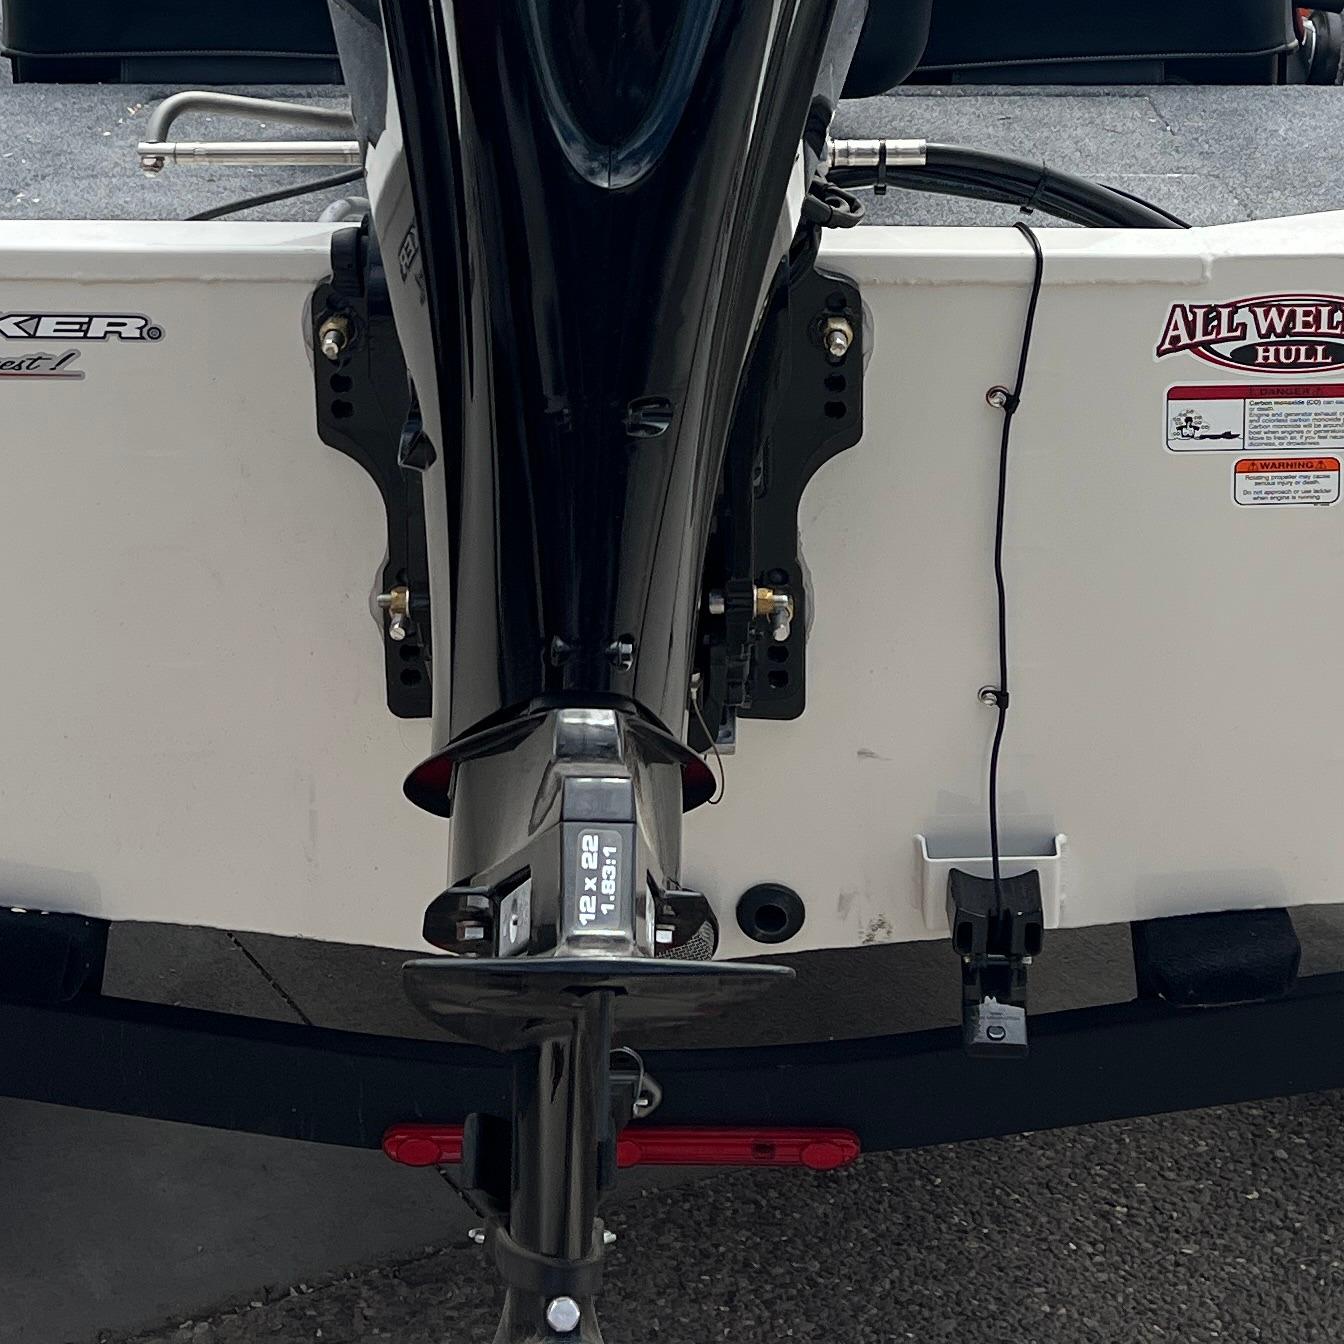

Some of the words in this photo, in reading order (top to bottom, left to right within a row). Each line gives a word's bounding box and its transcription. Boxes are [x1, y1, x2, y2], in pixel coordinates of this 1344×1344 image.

[1159, 305, 1246, 354] ALL
[1256, 346, 1331, 363] HULL
[581, 835, 599, 870] 22
[584, 876, 597, 891] x
[600, 846, 617, 915] 1.83:1
[579, 895, 597, 926] 12
